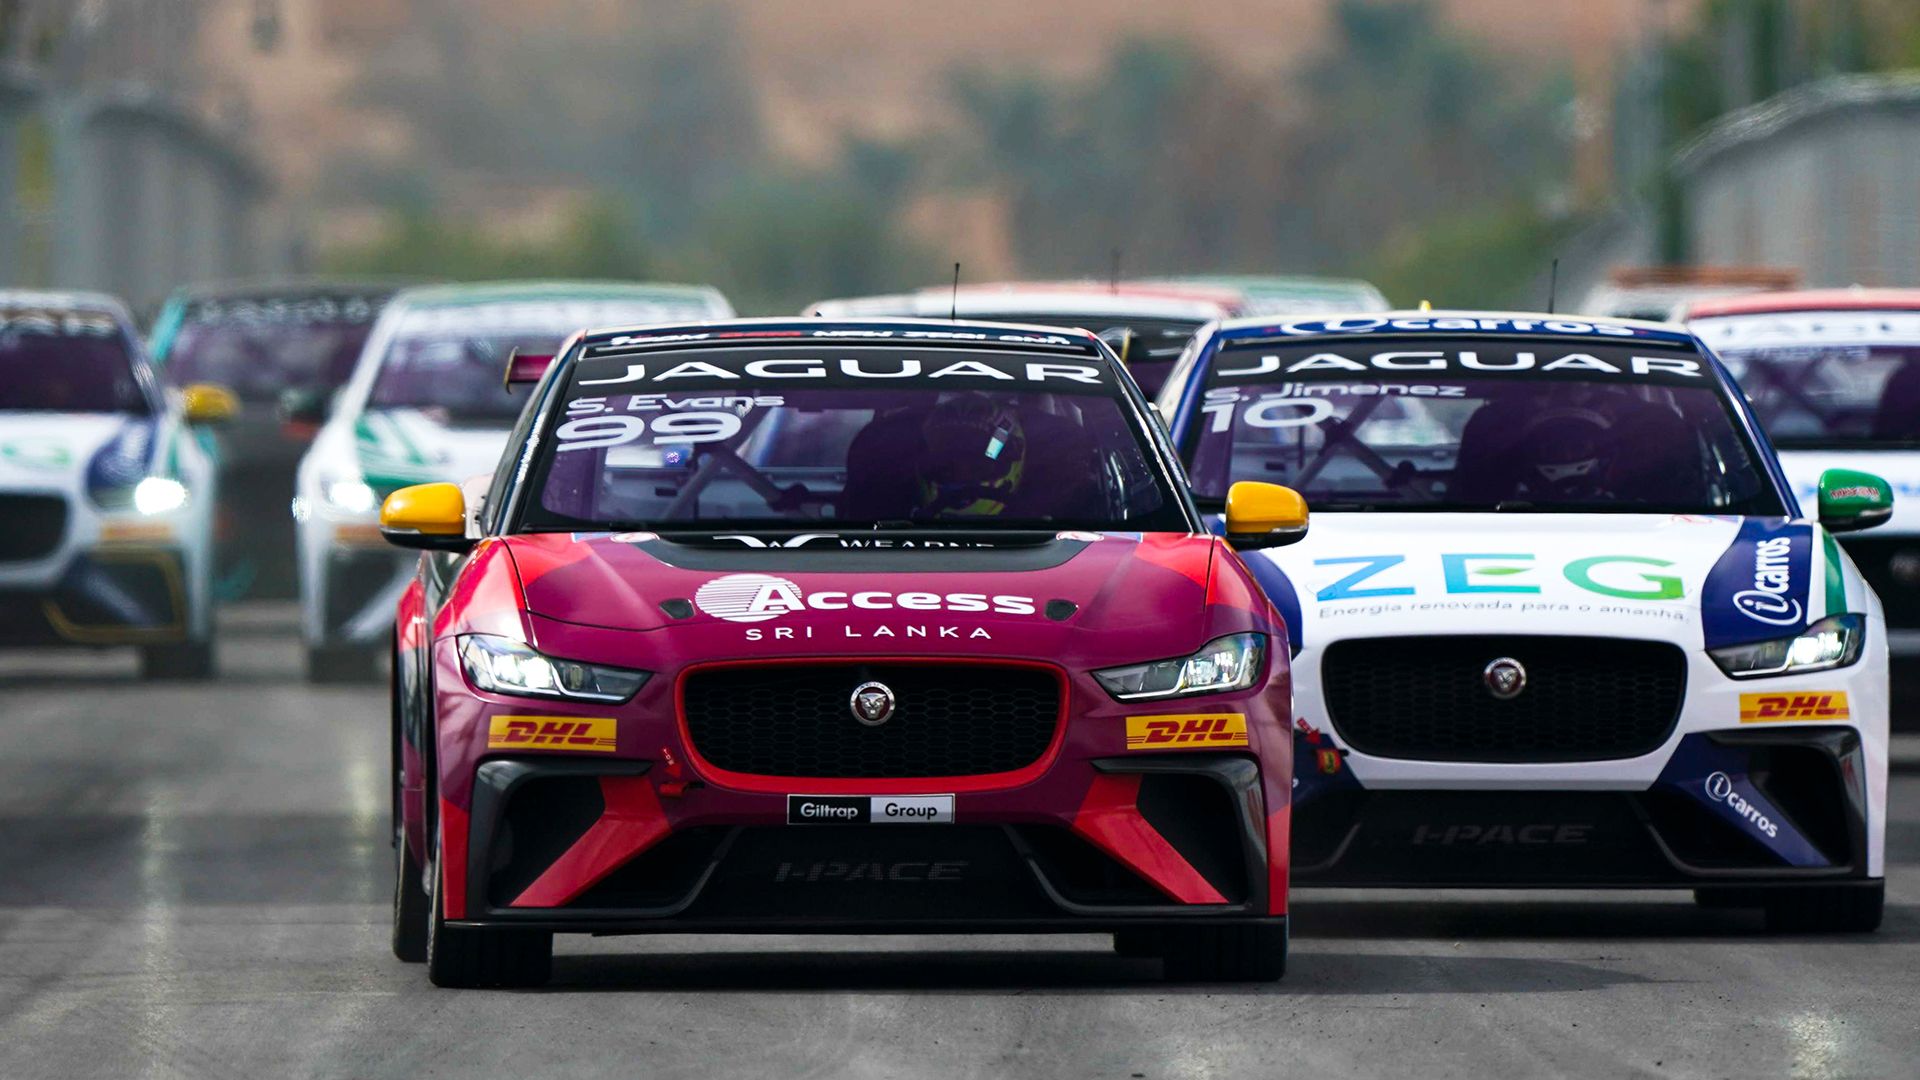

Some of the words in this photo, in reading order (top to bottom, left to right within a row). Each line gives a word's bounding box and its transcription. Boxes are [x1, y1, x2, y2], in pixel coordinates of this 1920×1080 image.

[578, 359, 1103, 385] JAGUAR
[1217, 351, 1703, 377] JAGUAR
[566, 396, 614, 416] S.
[627, 393, 785, 411] Evans
[1202, 386, 1249, 406] S.
[1260, 382, 1467, 400] Jimenez
[1202, 397, 1334, 433] 10
[555, 411, 743, 452] 99
[1313, 553, 1686, 601] ZEG
[747, 583, 1036, 616] Access
[1319, 602, 1402, 619] Energia
[1410, 600, 1513, 611] renovada
[1521, 602, 1569, 613] para
[1578, 604, 1591, 612] o
[745, 626, 813, 641] SRI
[845, 625, 992, 640] LANKA
[1755, 696, 1837, 718] DHL
[505, 721, 598, 744] DHL
[1144, 719, 1235, 743] DHL
[800, 802, 859, 821] Giltrap
[885, 803, 938, 821] Group
[1705, 771, 1778, 838] icarros
[1413, 824, 1594, 845] I-PACE
[775, 860, 969, 882] I-PACE
